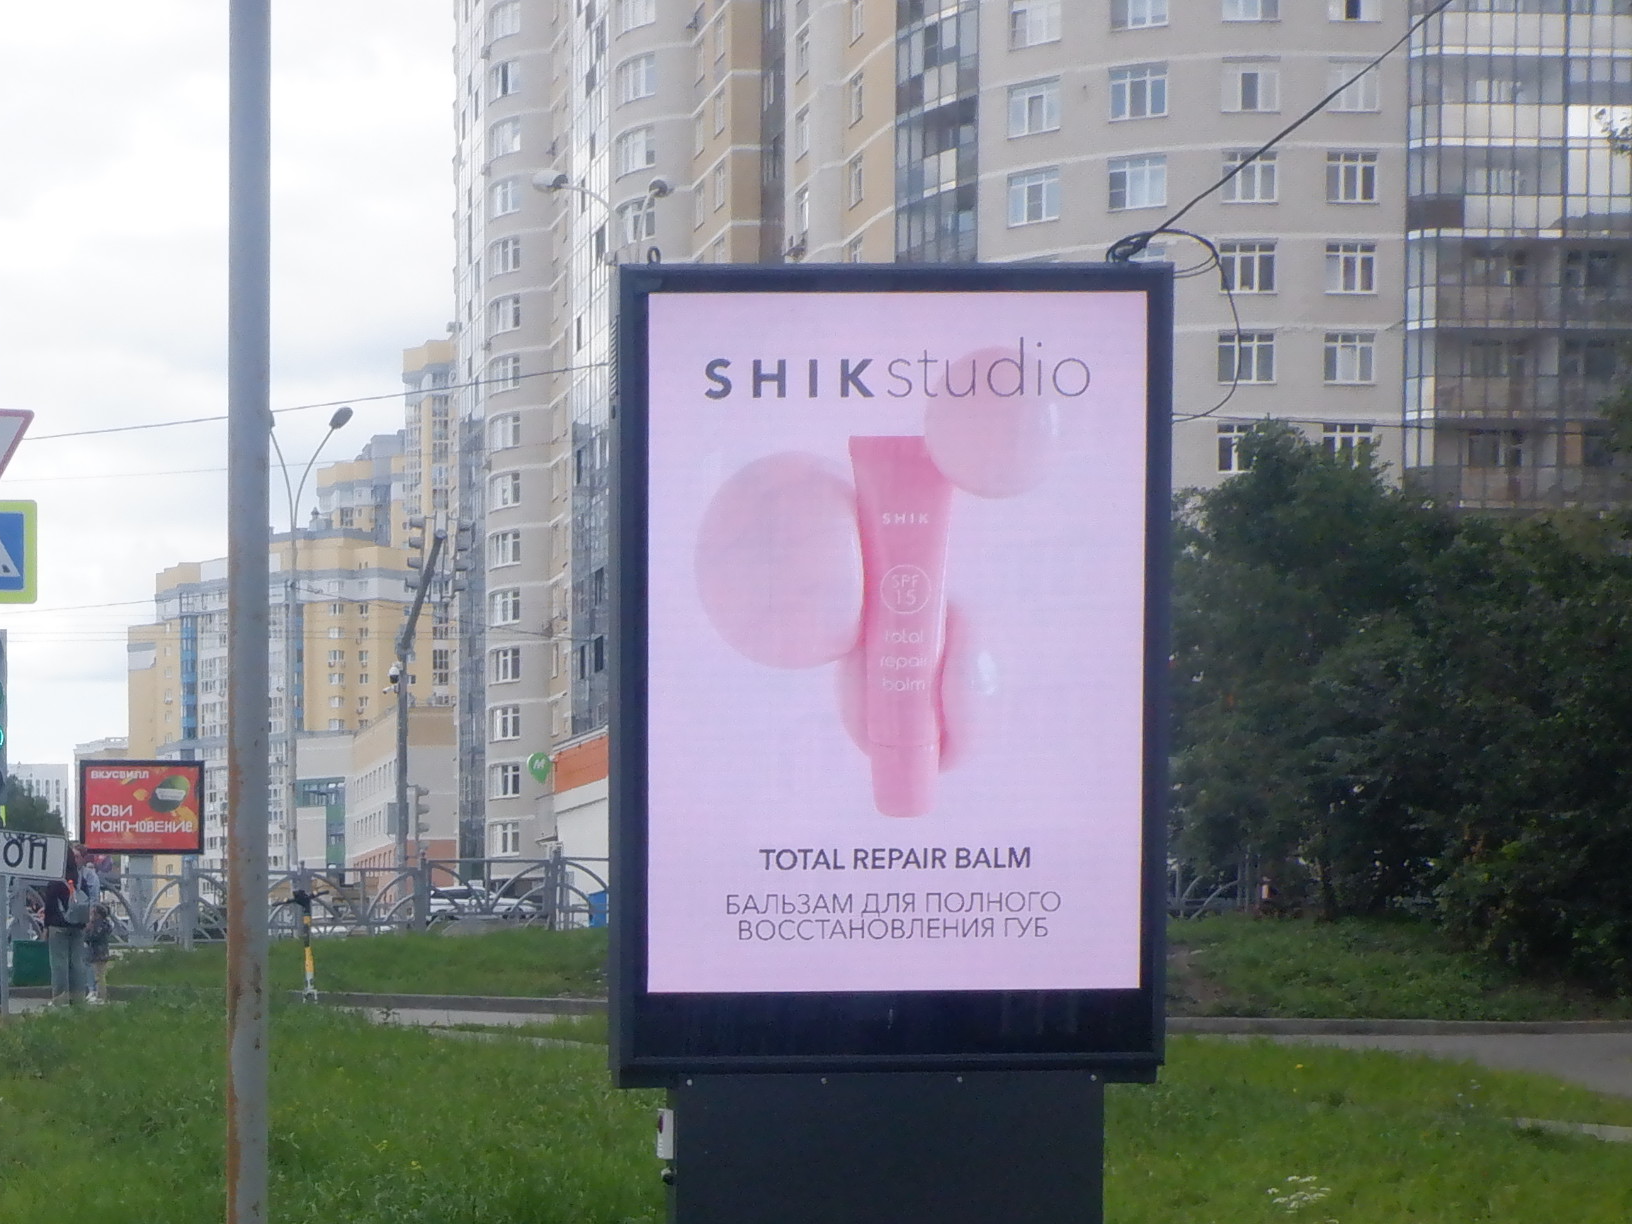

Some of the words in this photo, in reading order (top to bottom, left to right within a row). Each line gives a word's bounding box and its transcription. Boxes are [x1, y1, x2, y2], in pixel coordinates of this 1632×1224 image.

[881, 512, 929, 525] SHIK
[891, 574, 920, 589] SPF
[896, 589, 918, 605] 15
[90, 770, 149, 780] ВКУСВИЛЛ
[90, 804, 133, 817] ЛОВИ
[758, 848, 846, 870] TOTAL
[852, 847, 947, 870] REPAIR
[954, 846, 1032, 869] BALM
[726, 893, 853, 915] БАЛЬЗАМ
[860, 893, 916, 917] ДЛЯ
[925, 891, 1062, 914] ПОЛНОГО
[738, 917, 995, 941] ВОССТАНОВЛЕНИЯ
[1003, 916, 1049, 938] ГУБ
